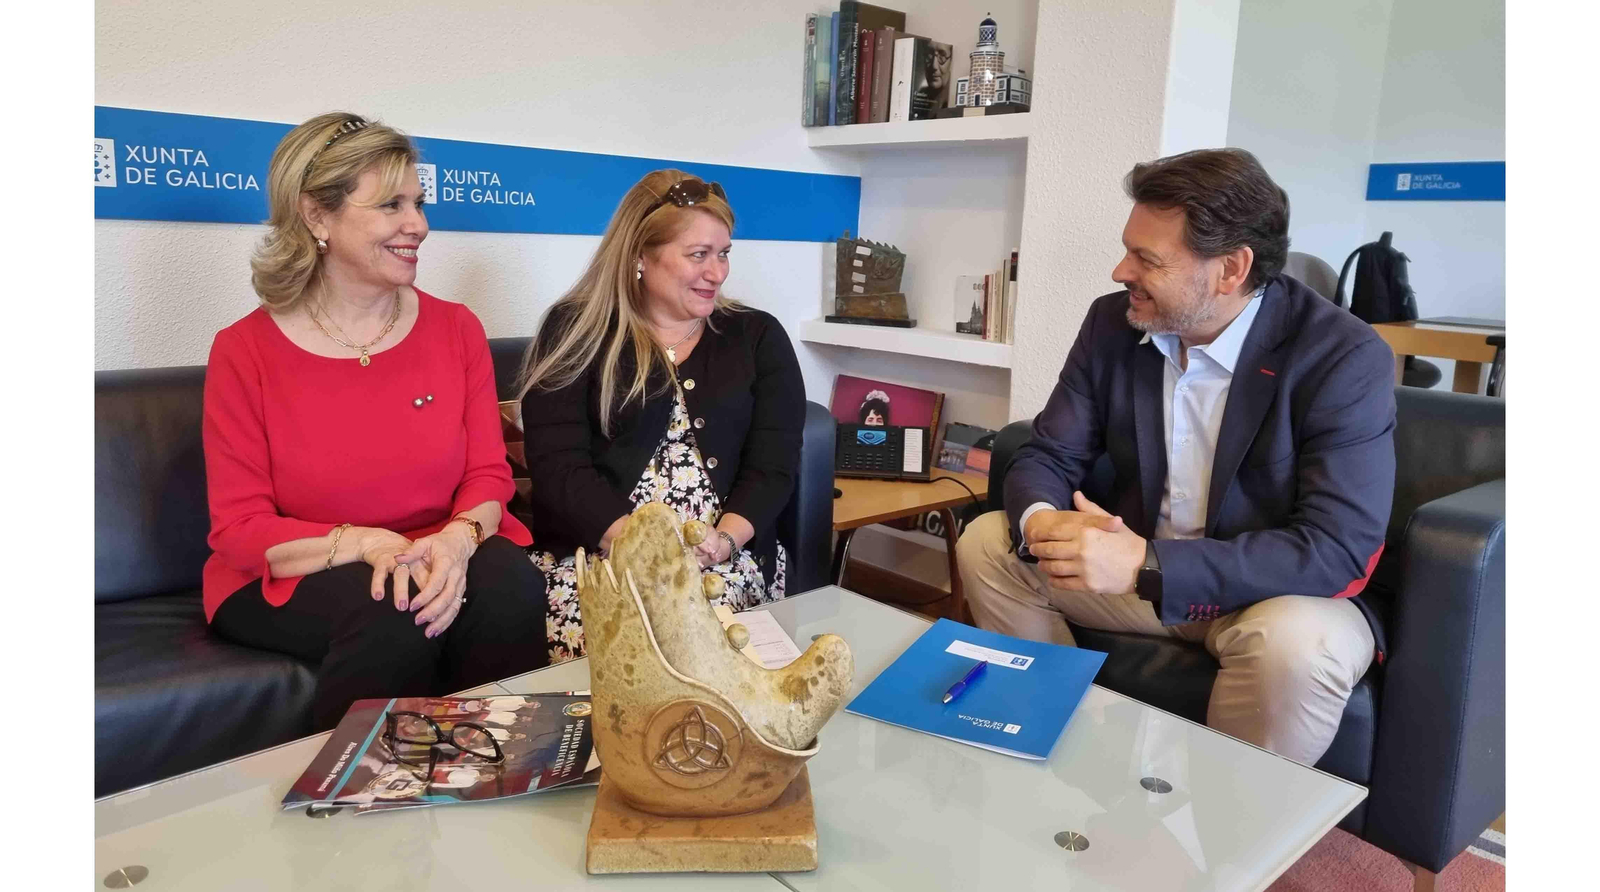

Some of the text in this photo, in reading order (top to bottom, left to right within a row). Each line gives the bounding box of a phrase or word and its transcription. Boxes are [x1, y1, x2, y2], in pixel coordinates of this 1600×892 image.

[125, 144, 210, 167] XUNTA
[125, 166, 260, 191] DE GALICIA
[443, 168, 501, 187] XUNTA
[1412, 181, 1461, 190] DE GALICIA
[1414, 173, 1443, 182] XUNTA
[442, 186, 536, 206] DE GALICIA
[564, 724, 574, 733] DE
[958, 714, 1004, 728] DE GALICIA
[972, 720, 1003, 730] XUNTA
[571, 719, 586, 749] SOCIEDAD
[551, 733, 572, 777] BENEFICENCIA
